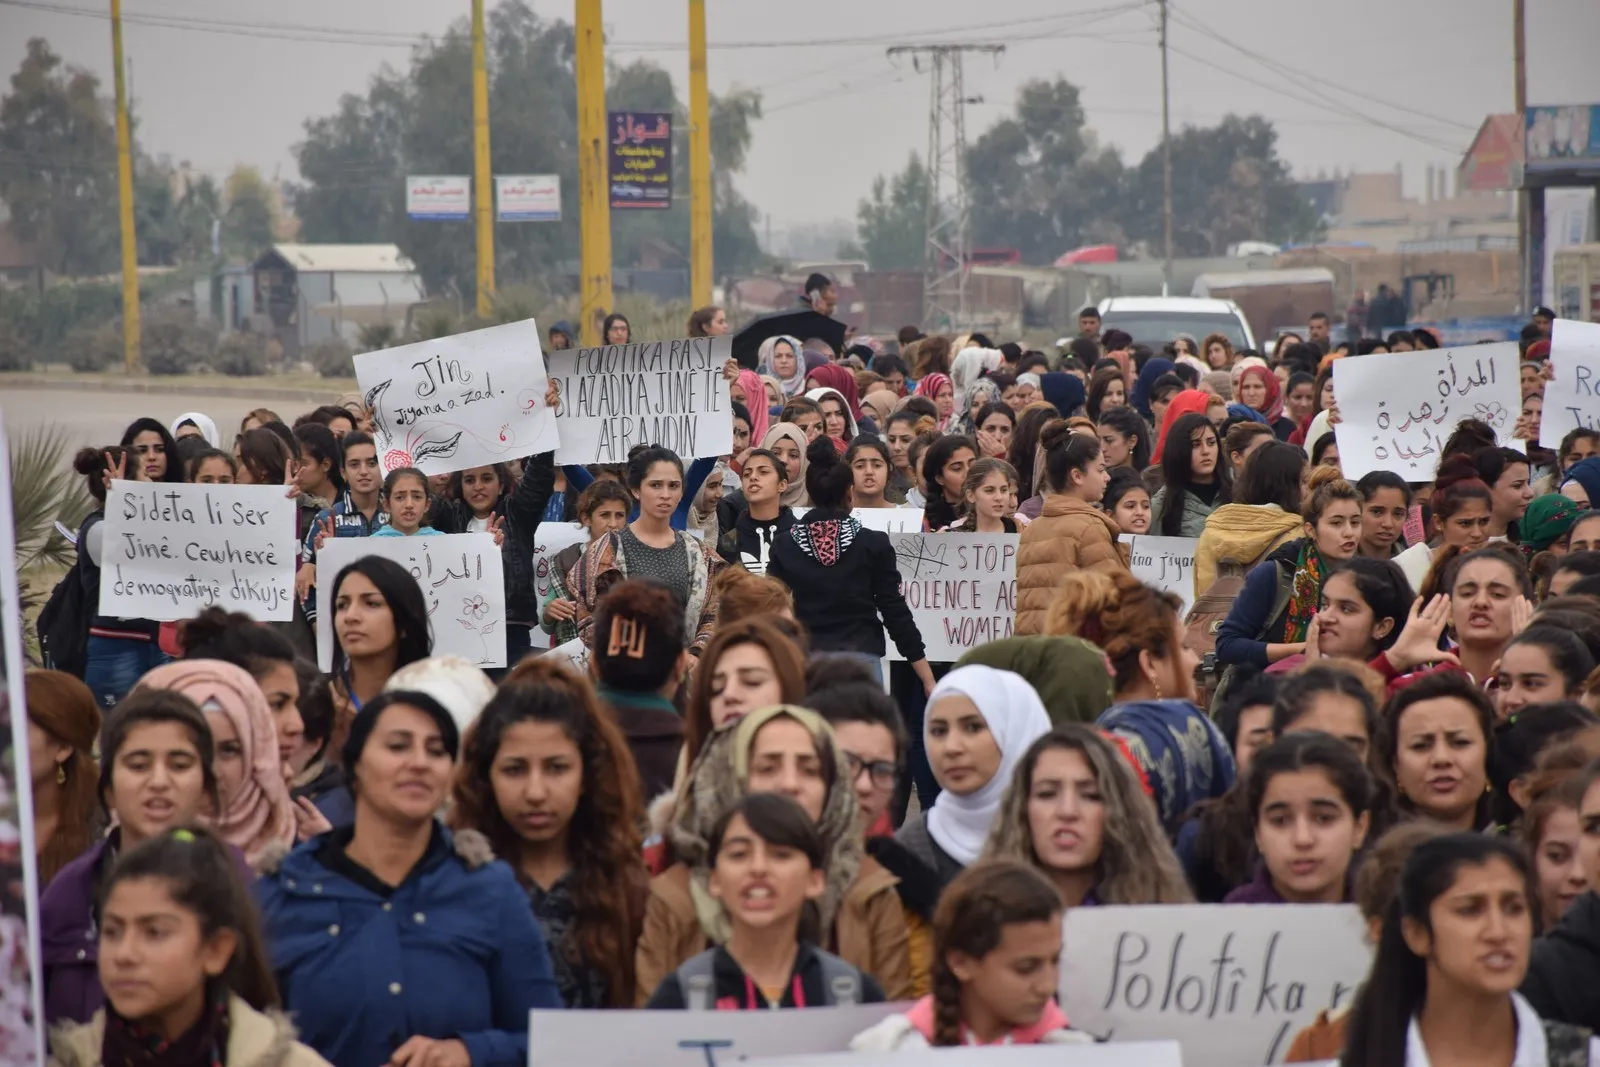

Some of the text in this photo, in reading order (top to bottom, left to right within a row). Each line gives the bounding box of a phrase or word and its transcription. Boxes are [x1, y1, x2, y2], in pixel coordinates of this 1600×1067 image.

[669, 337, 717, 371] RAST
[411, 355, 473, 400] Jin
[576, 372, 651, 418] AZADIYA
[655, 369, 698, 414] JINÊ
[703, 366, 723, 412] TÊ
[1438, 352, 1495, 397] المرأة
[1377, 400, 1448, 432] زهرة
[206, 493, 222, 524] li
[410, 542, 482, 588] المرأة
[957, 543, 1015, 573] STOP
[898, 580, 982, 610] IOLENCE
[1103, 931, 1307, 1020] Polotîka
